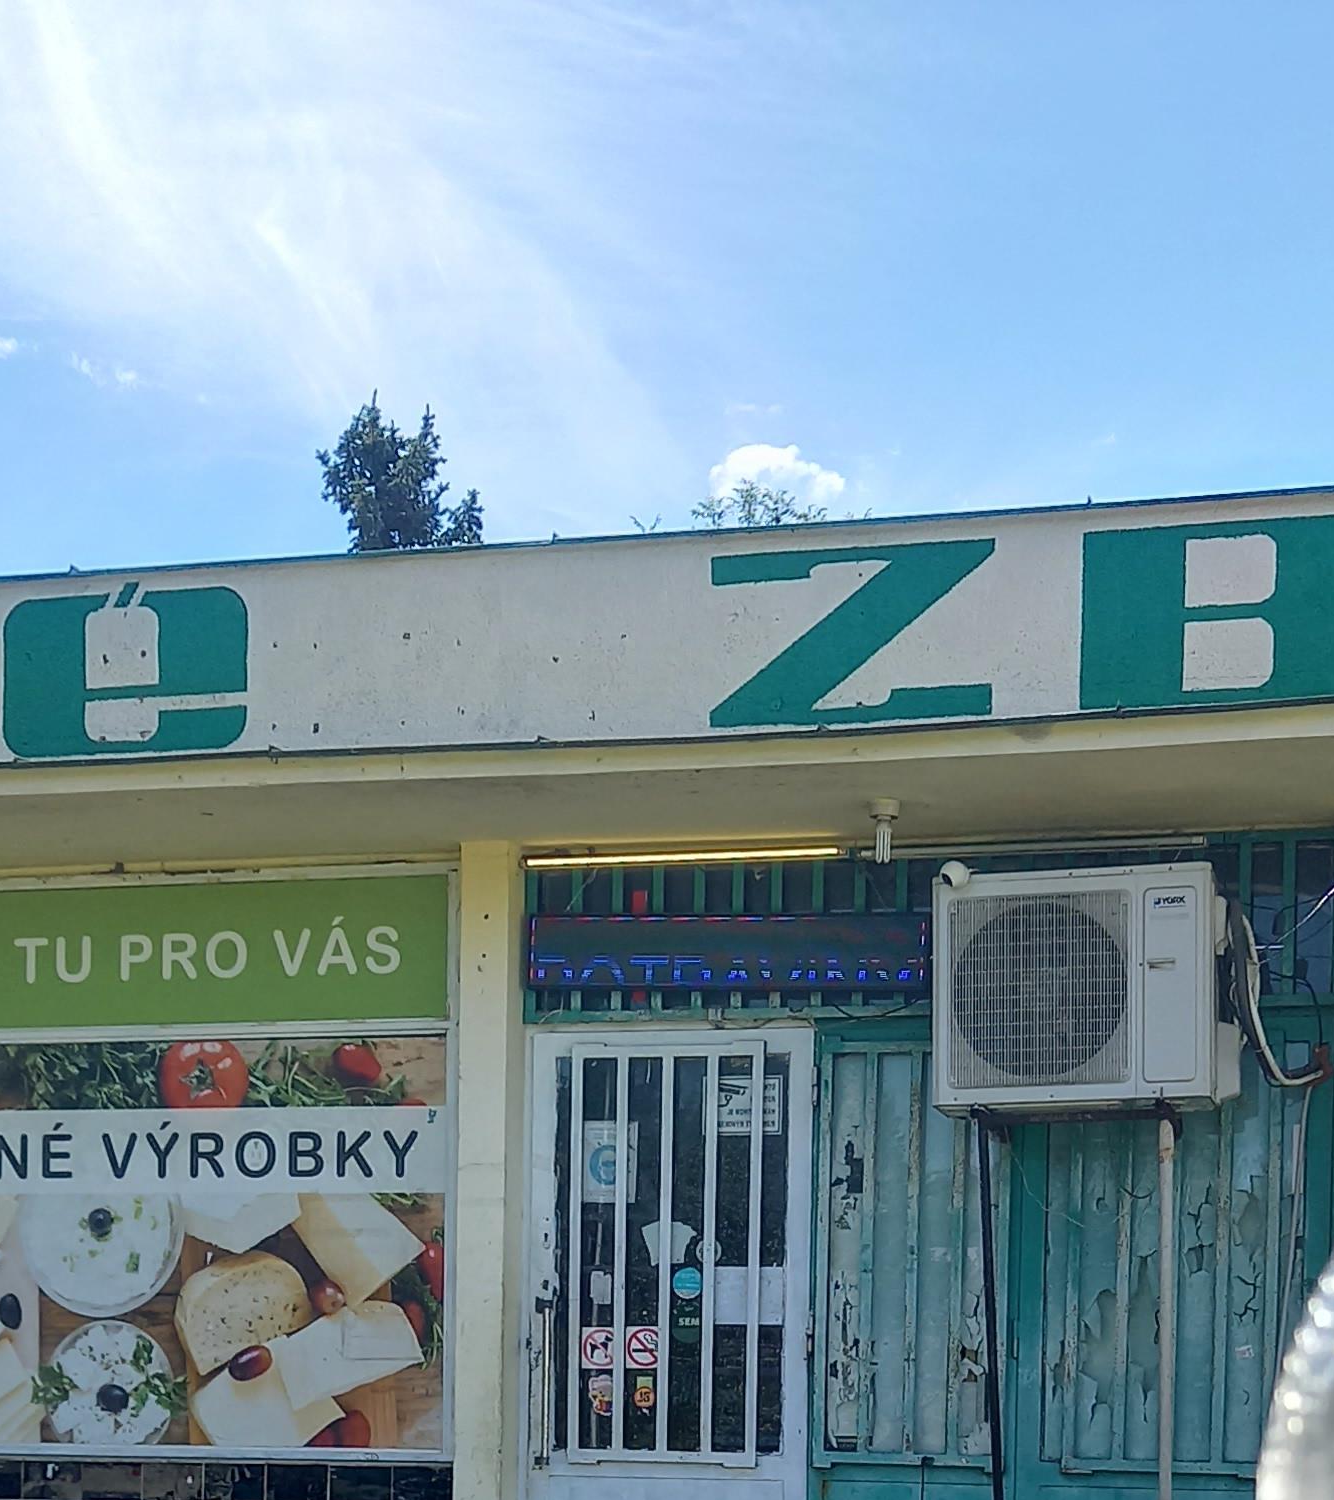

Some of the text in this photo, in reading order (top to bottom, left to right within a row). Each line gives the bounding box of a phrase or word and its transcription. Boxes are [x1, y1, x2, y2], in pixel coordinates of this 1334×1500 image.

[14, 936, 92, 983] TU
[120, 930, 248, 981] PRO
[273, 916, 403, 976] VÁS
[102, 1120, 419, 1178] VÝROBKY
